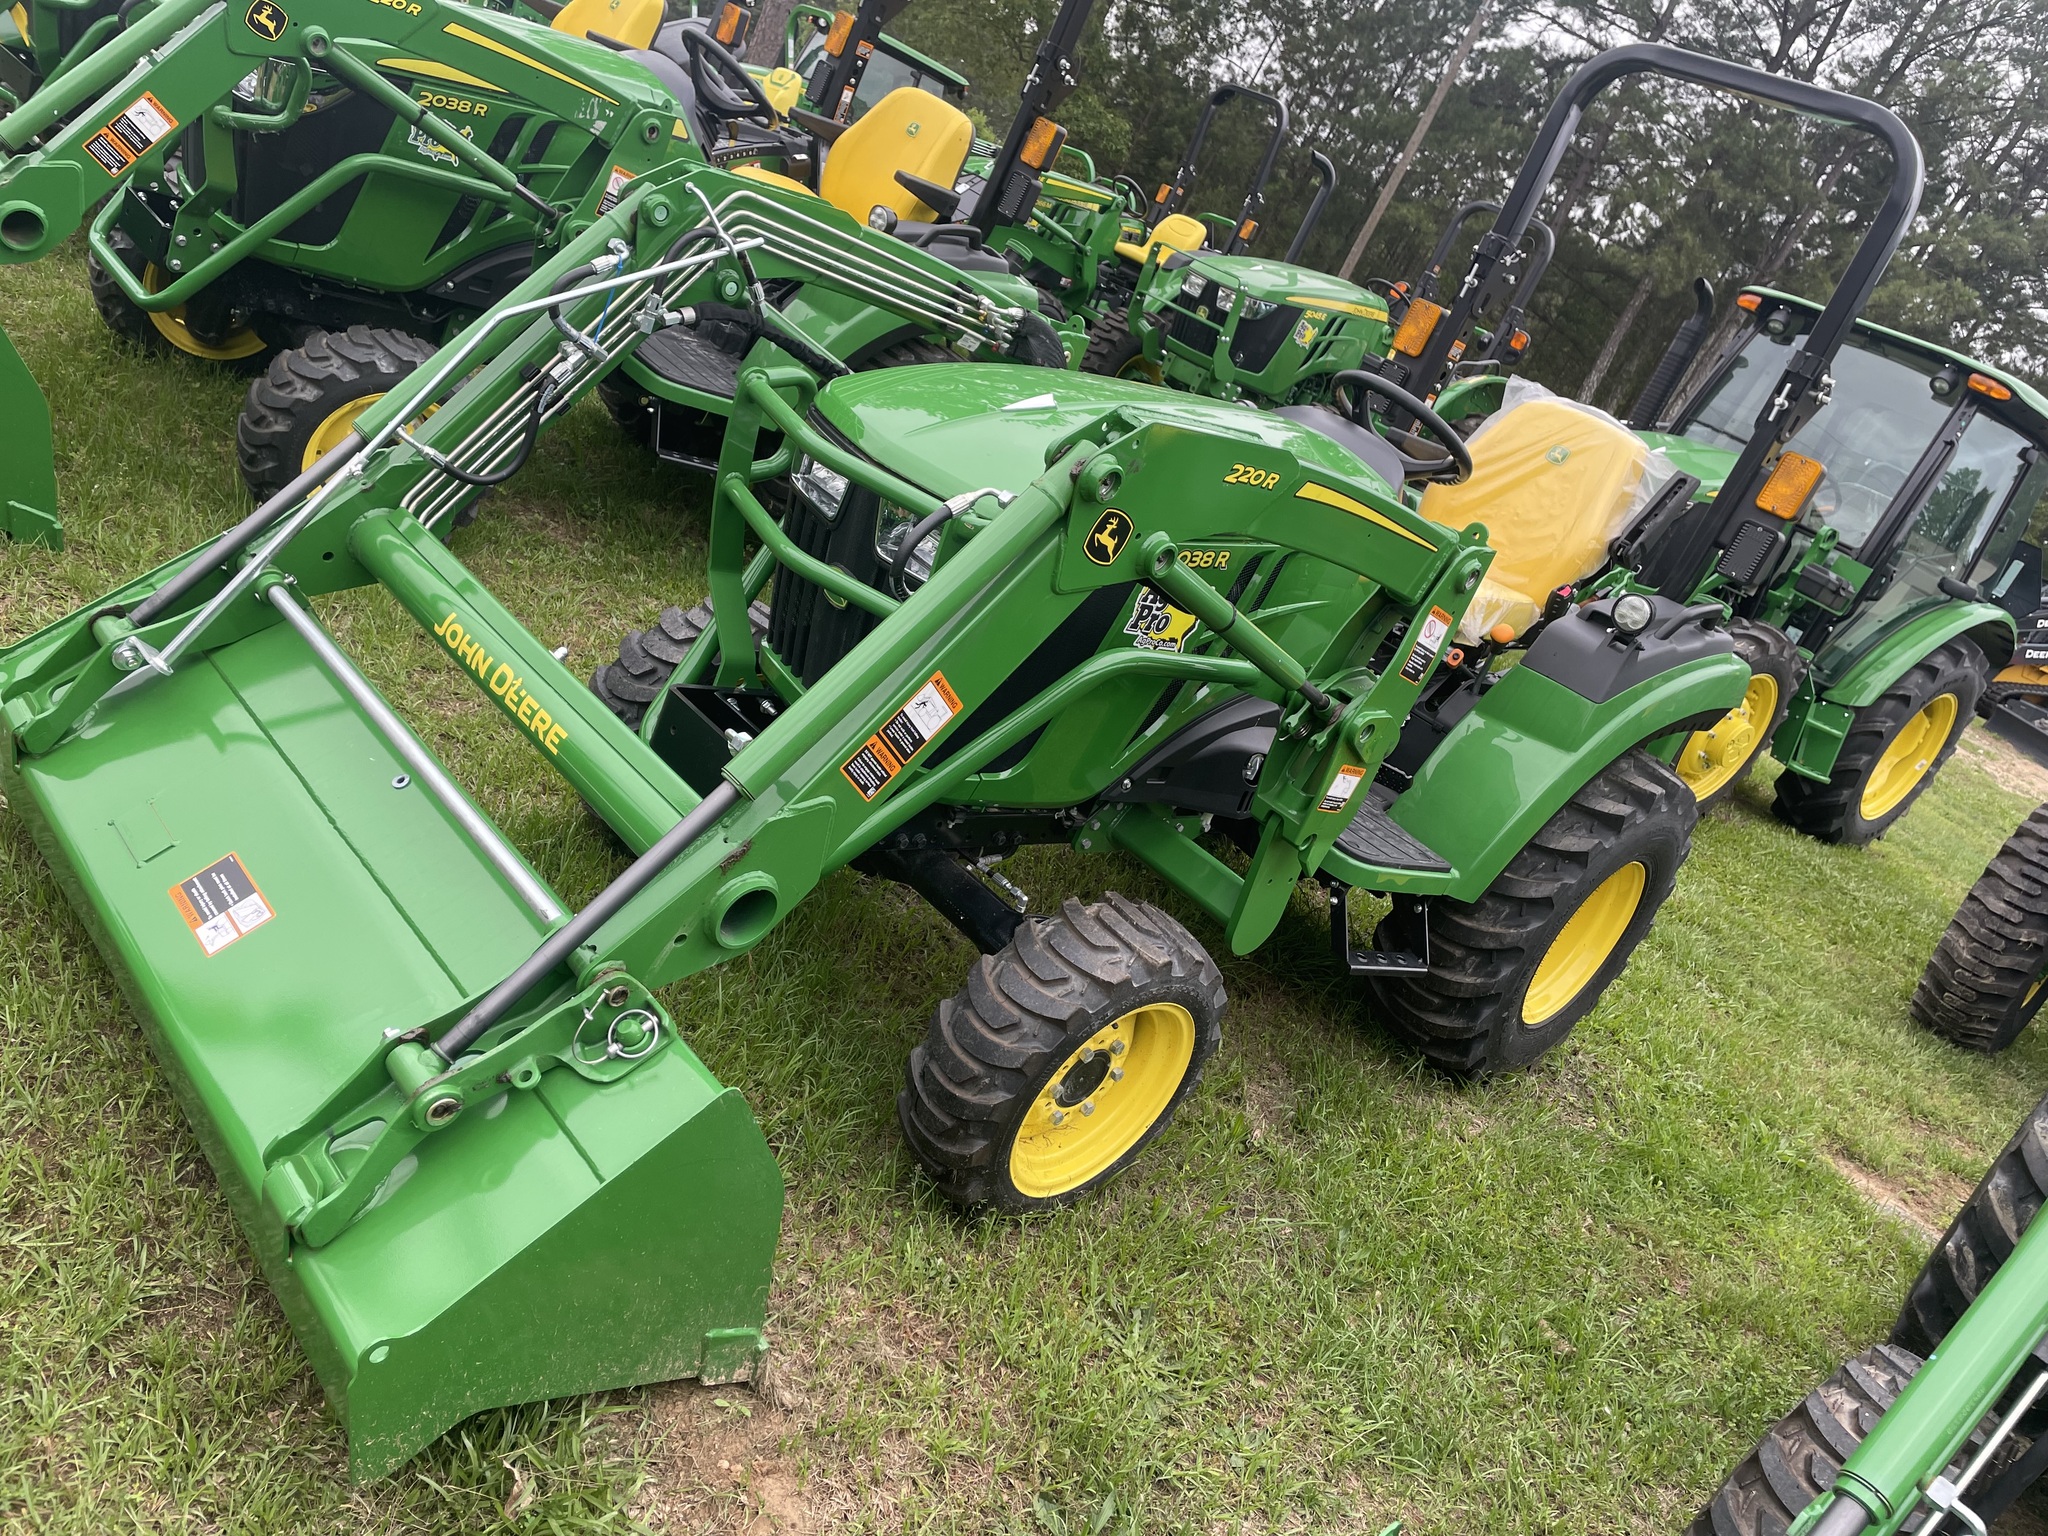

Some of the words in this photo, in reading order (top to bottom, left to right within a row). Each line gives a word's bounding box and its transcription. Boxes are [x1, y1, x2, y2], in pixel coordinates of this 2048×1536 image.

[153, 102, 174, 124] WARNING
[111, 138, 131, 160] WARNING
[1177, 548, 1231, 569] 038R
[1129, 603, 1171, 634] Pro
[433, 612, 494, 680] JOHN
[489, 662, 569, 756] DEERE
[939, 682, 958, 710] WARNING
[875, 747, 896, 772] WARNING
